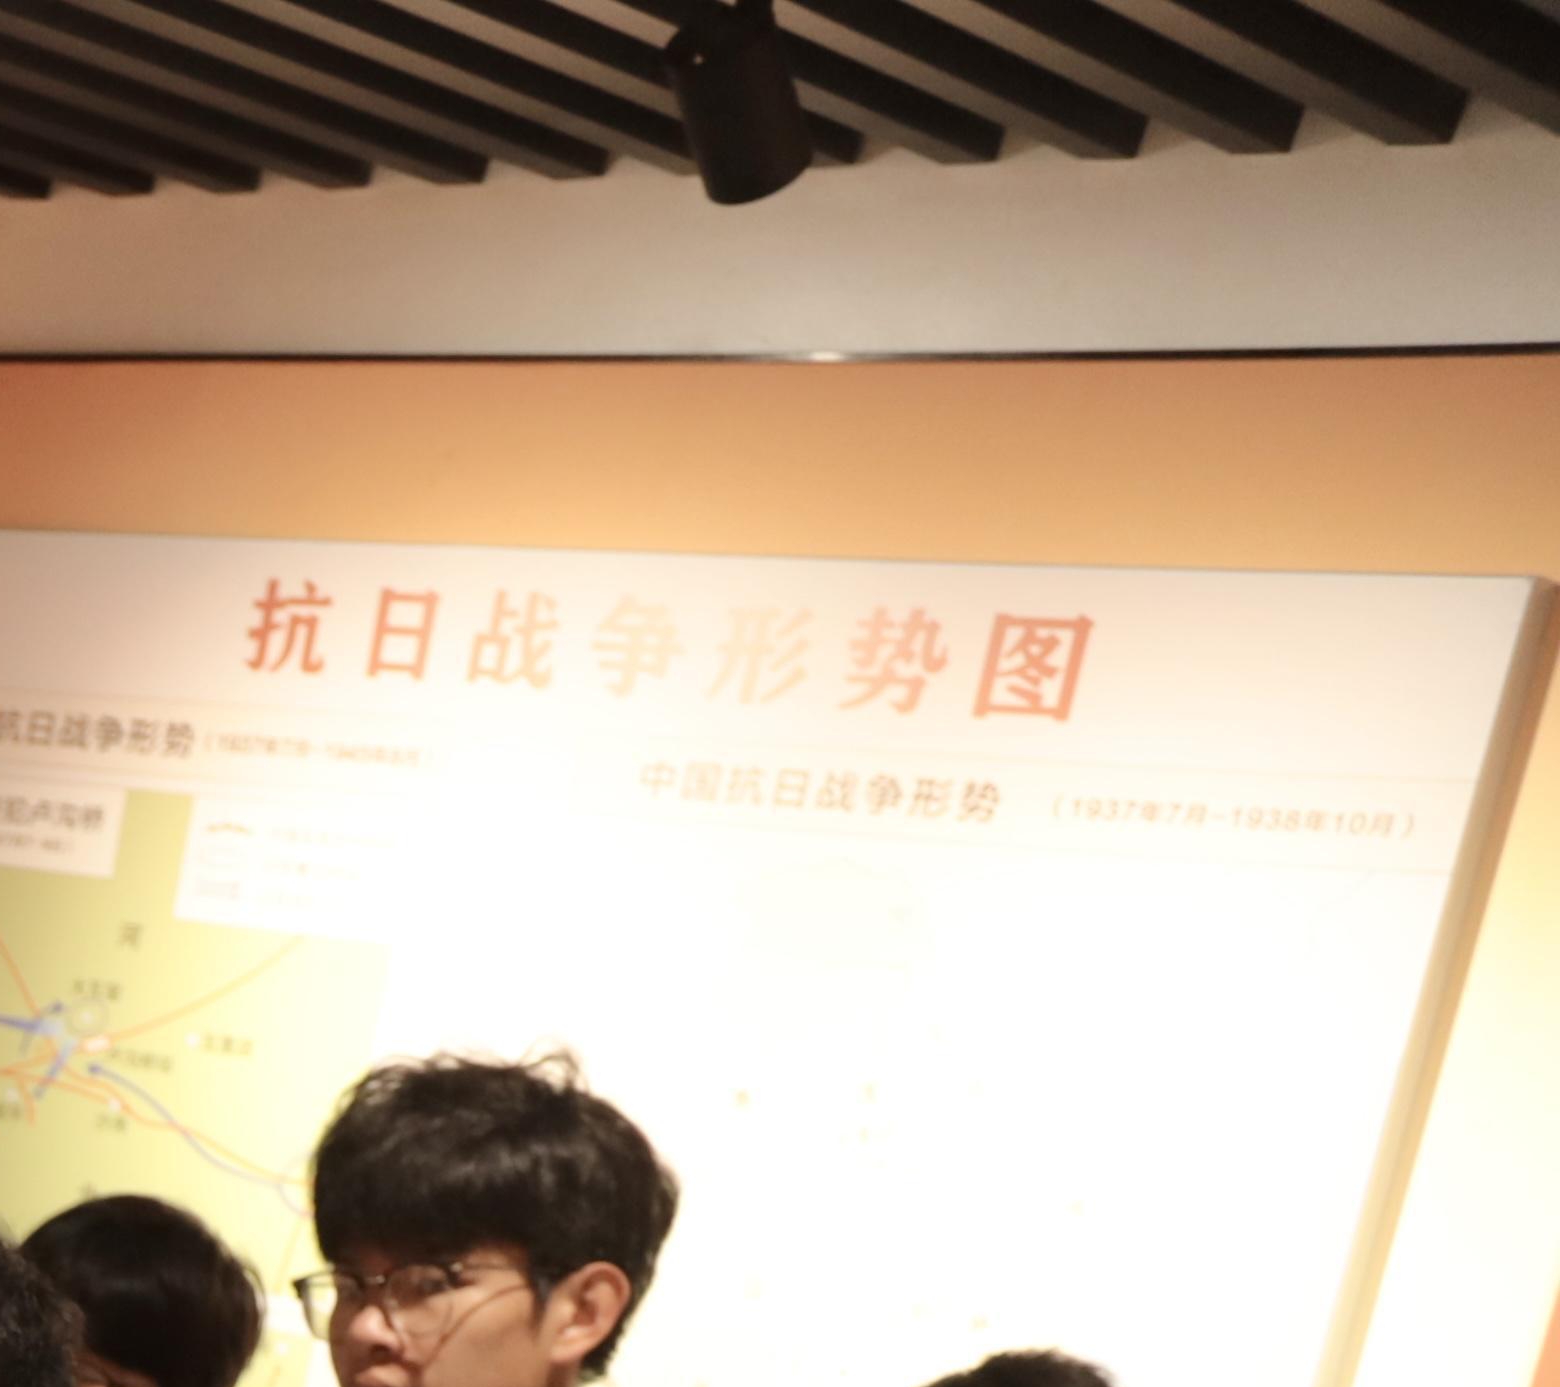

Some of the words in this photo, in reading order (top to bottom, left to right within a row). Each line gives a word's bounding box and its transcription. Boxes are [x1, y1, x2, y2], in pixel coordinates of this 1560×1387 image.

[245, 577, 1096, 722] 抗日战争形势图
[636, 759, 1003, 826] 中国抗日战争形势
